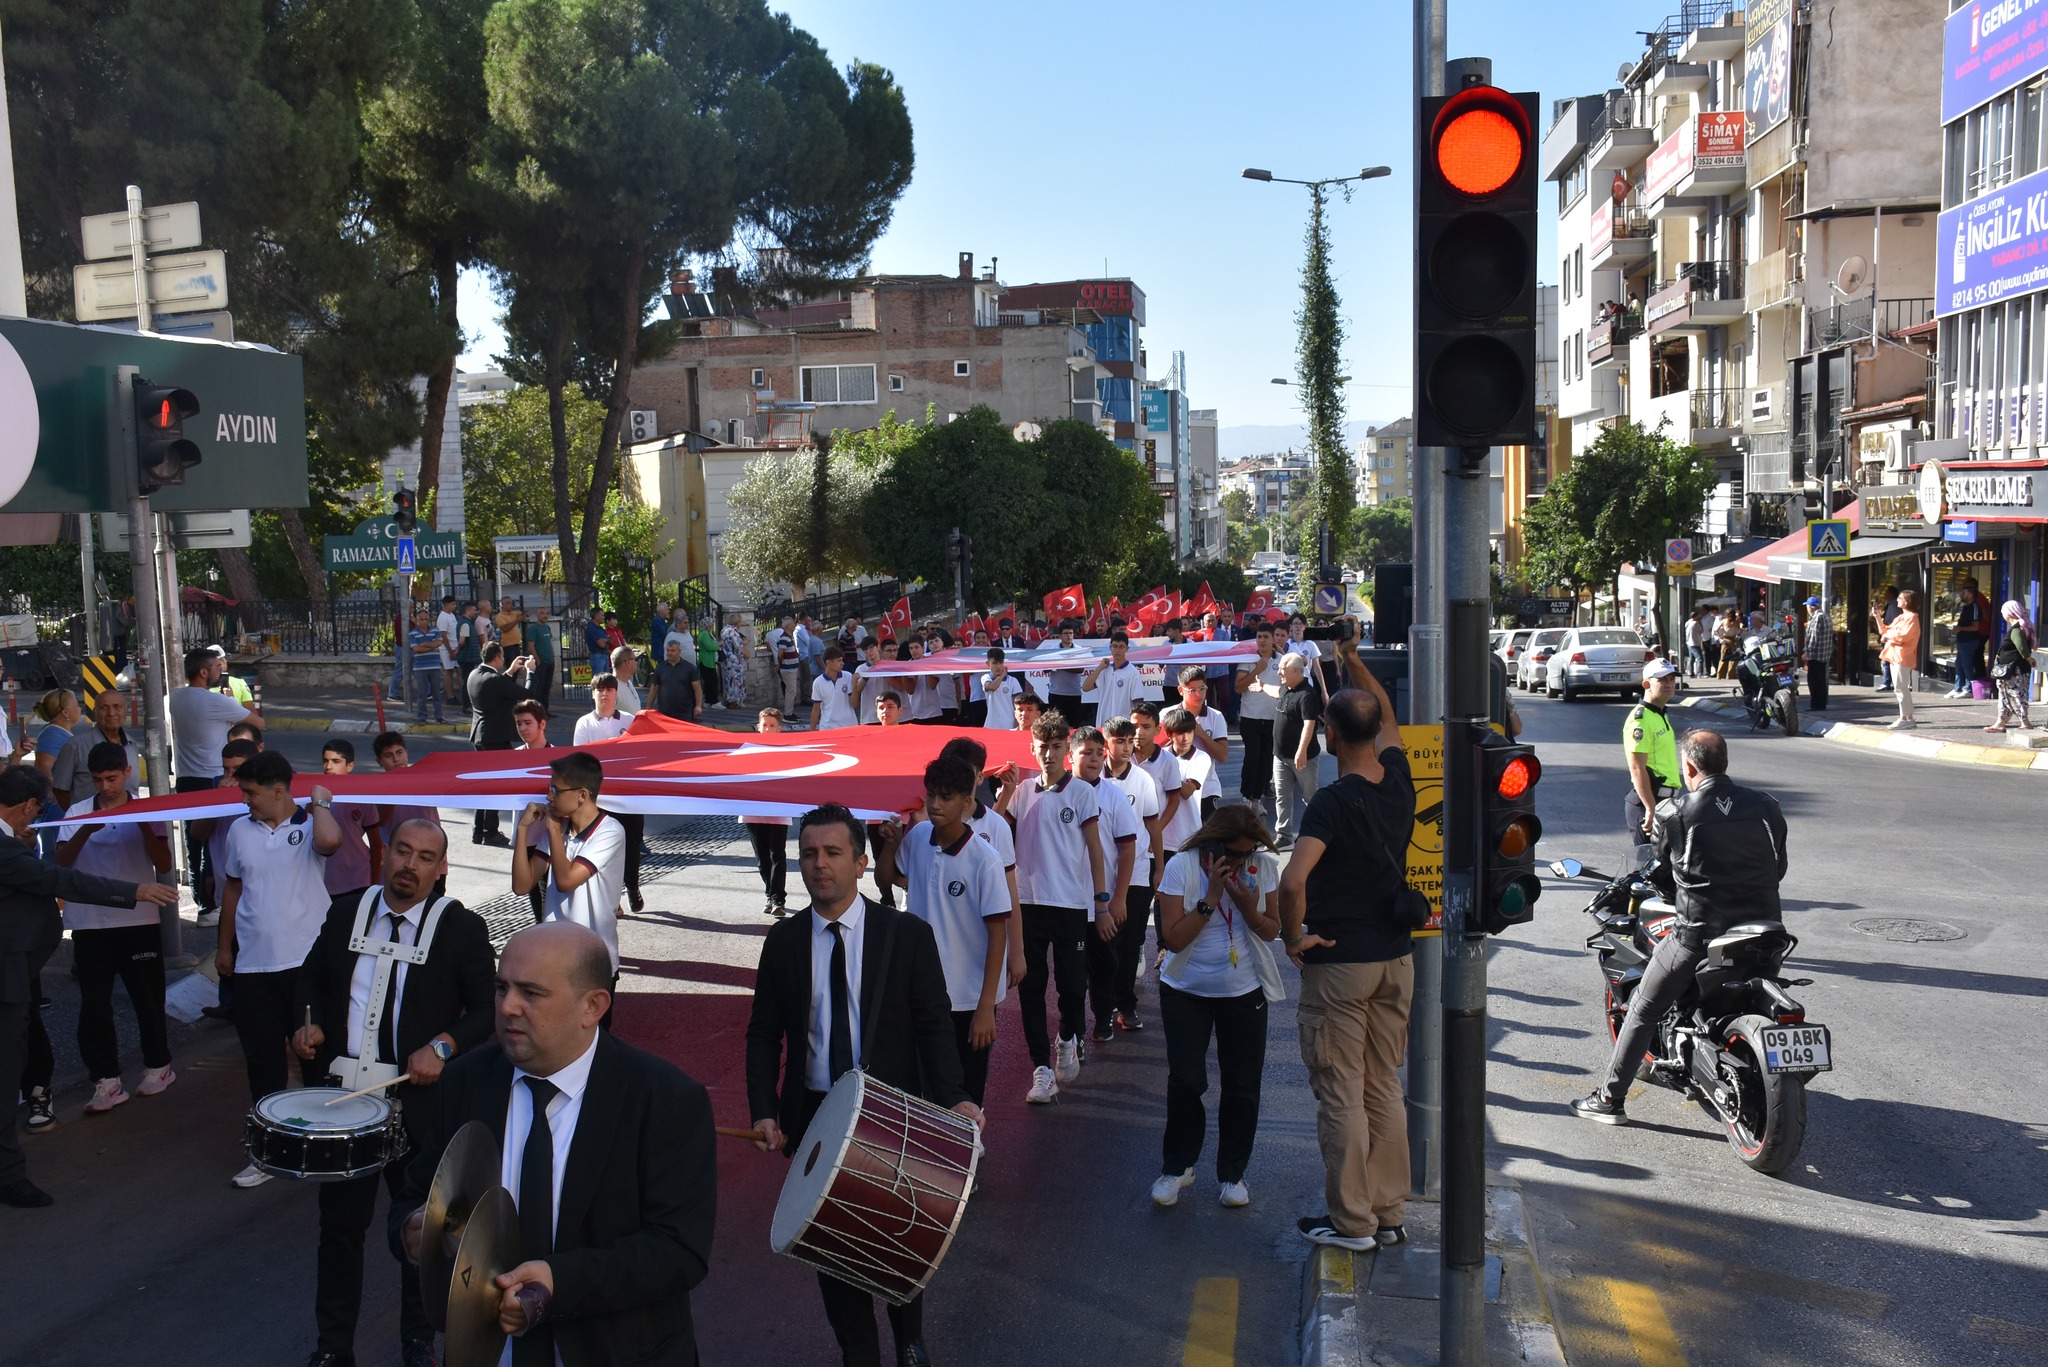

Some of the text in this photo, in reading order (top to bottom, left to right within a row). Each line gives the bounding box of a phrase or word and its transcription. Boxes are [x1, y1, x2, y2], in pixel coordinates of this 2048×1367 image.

[1981, 0, 2023, 37] GENEL
[1708, 137, 1734, 146] SÖNMEZ
[1698, 158, 1713, 166] 0532
[1714, 157, 1726, 165] 494
[1735, 156, 1743, 164] 09
[1987, 196, 2005, 211] AYDIN
[1967, 204, 2023, 257] İNGİLİZ
[1081, 284, 1130, 300] OTEL
[1975, 283, 1987, 302] 95
[216, 413, 277, 444] AYDIN
[1925, 487, 1936, 503] EFE
[1945, 476, 2028, 509] ŞEKERLEME
[332, 546, 390, 563] RAMAZAN
[422, 541, 456, 560] CAMİİ
[1931, 549, 1997, 564] KAVASGİL
[574, 667, 591, 675] WC
[1766, 1029, 1824, 1048] 09 ABK
[1781, 1047, 1814, 1065] 049
